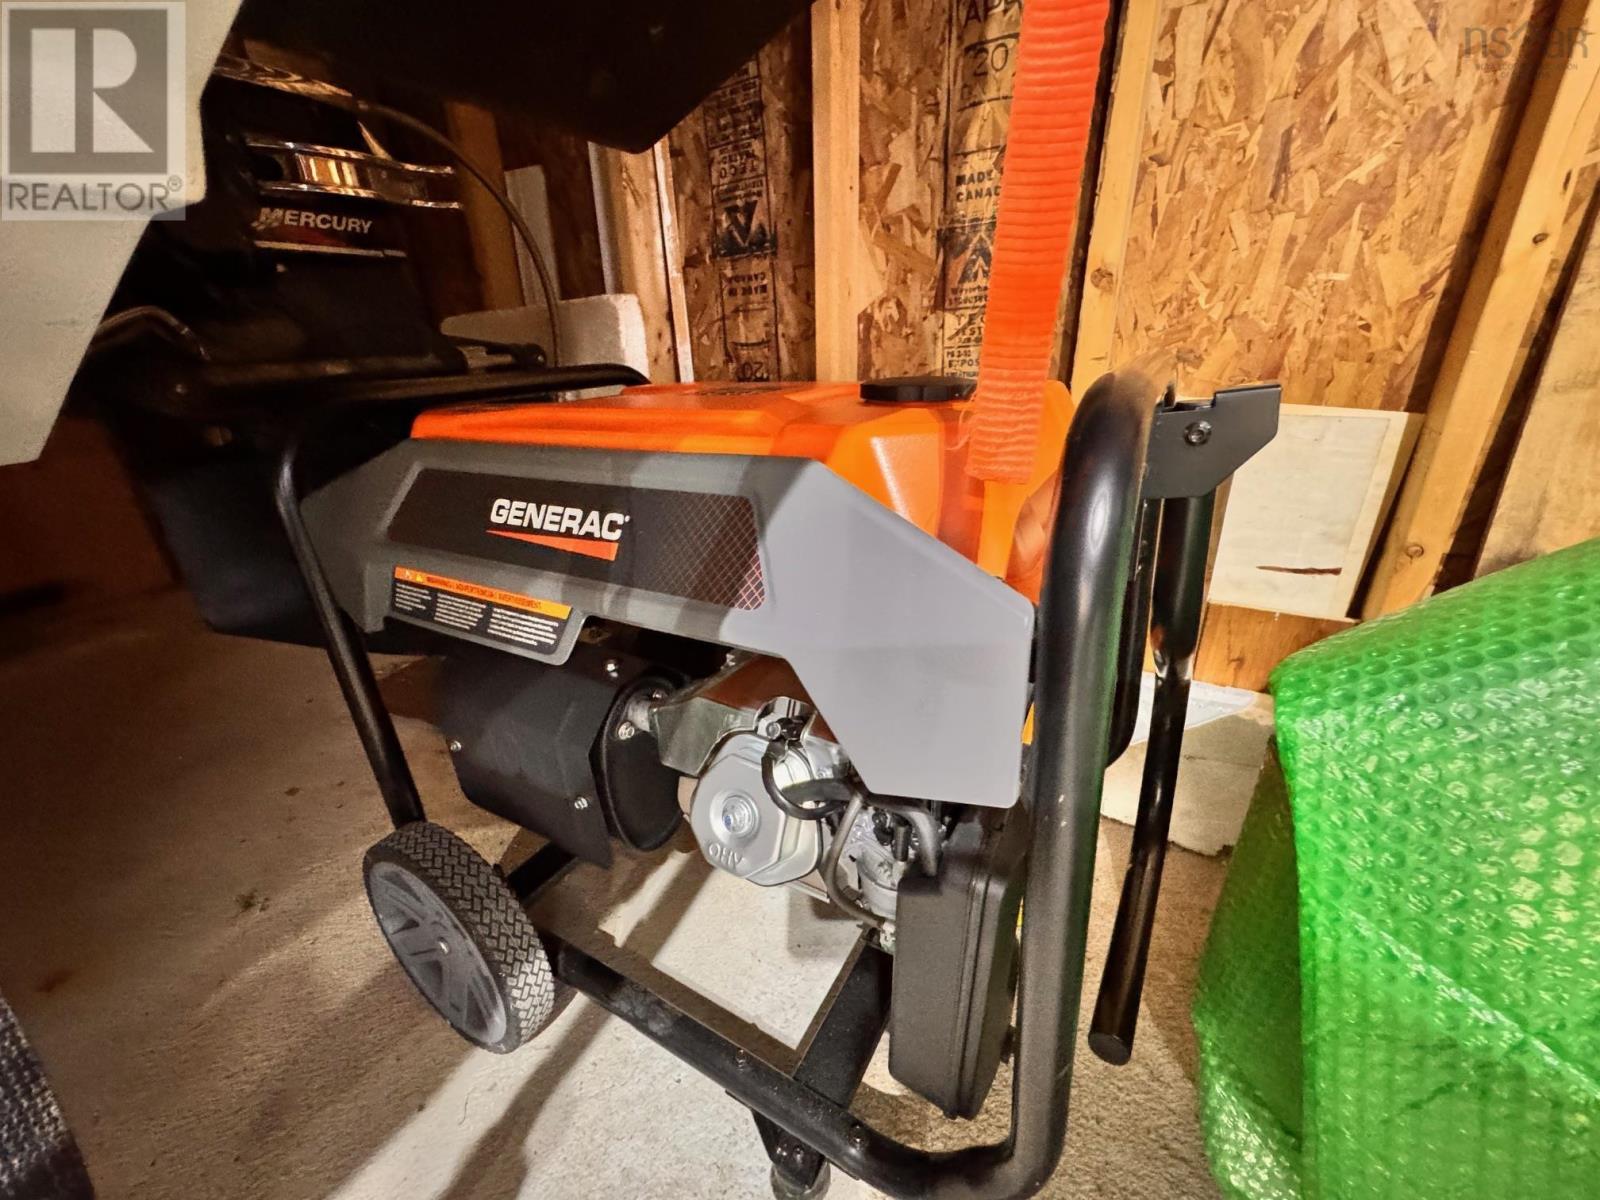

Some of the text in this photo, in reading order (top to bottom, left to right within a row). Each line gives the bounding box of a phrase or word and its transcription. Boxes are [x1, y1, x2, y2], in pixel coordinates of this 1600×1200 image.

[973, 42, 1009, 78] 20
[251, 206, 373, 235] MERCURY
[490, 498, 626, 541] GENERAC
